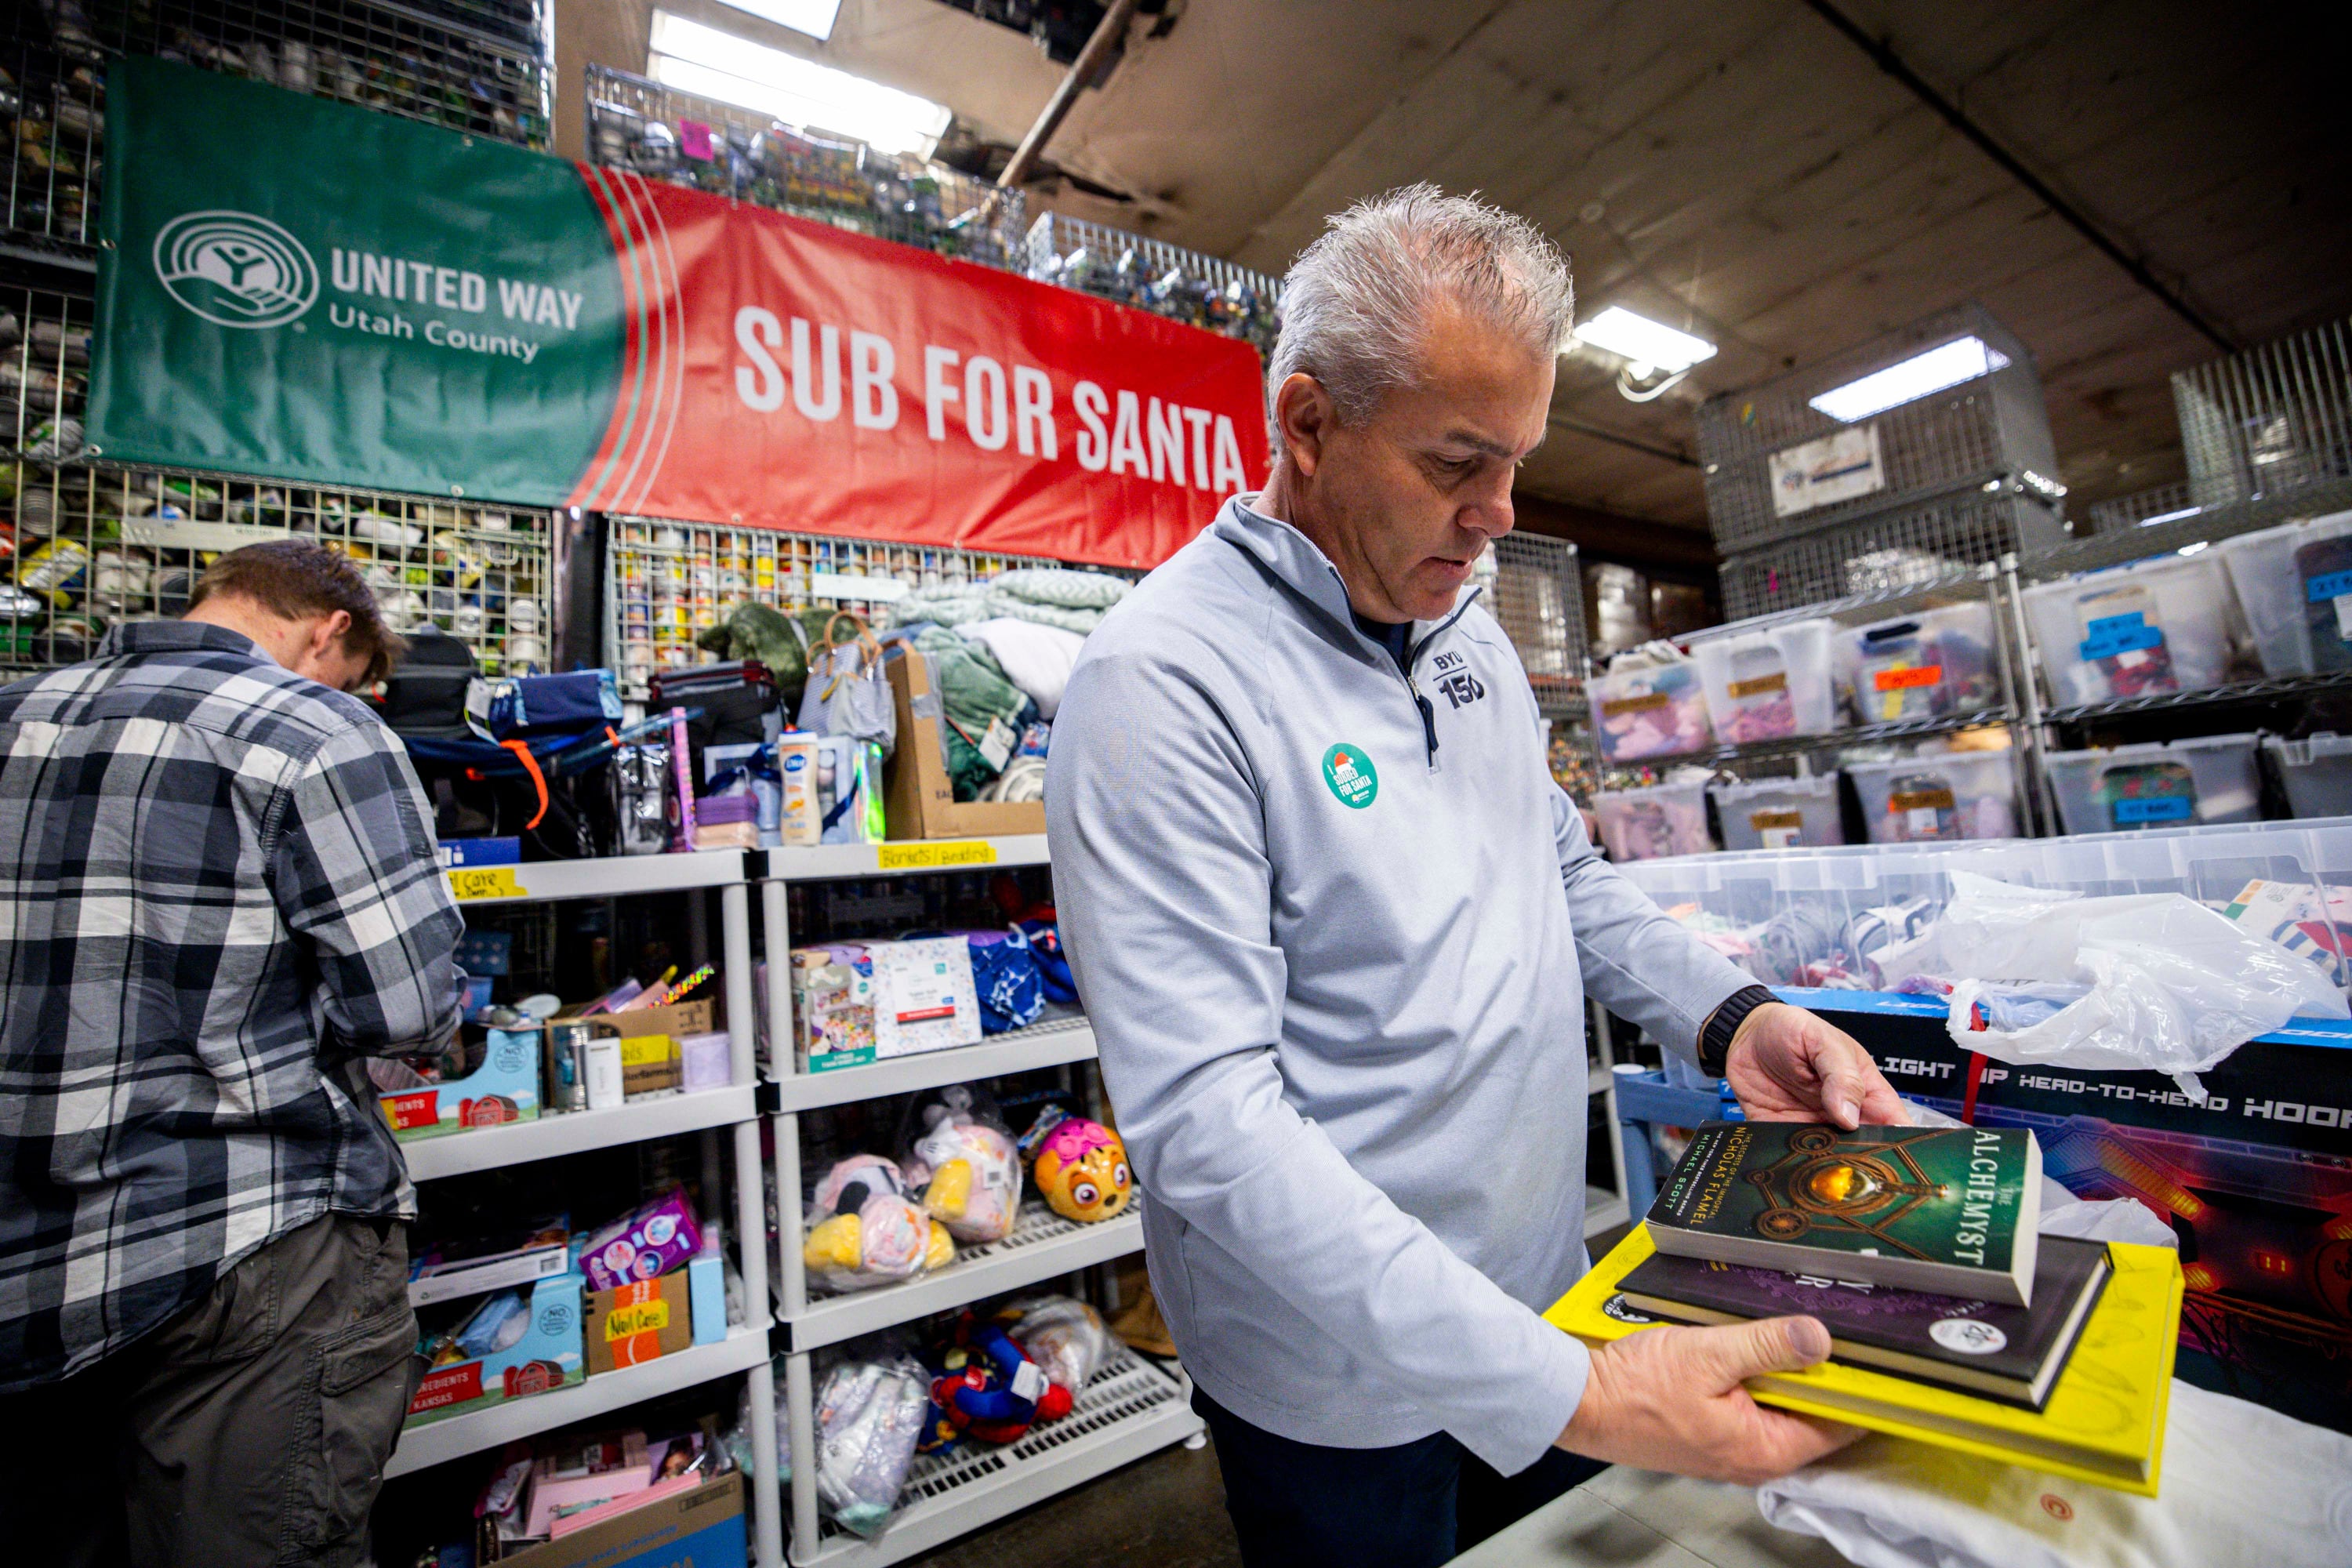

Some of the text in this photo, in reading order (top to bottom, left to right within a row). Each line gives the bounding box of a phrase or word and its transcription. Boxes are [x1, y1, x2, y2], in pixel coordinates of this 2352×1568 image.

[331, 248, 583, 331] UNITED WAY
[329, 303, 539, 365] Utah County
[734, 306, 1248, 493] SUB FOR SANTA
[1433, 651, 1463, 670] BYU
[1439, 673, 1484, 710] 150
[1327, 764, 1334, 775] I
[1333, 768, 1359, 786] SUBBED
[1339, 782, 1354, 797] FOR
[1350, 775, 1372, 791] SANTA
[1744, 1134, 1753, 1144] THE
[1713, 1127, 1747, 1178] NICHOLAS
[1733, 1145, 1748, 1166] SECRETS
[1665, 1134, 1710, 1210] MICHAEL SCOTT
[1723, 1177, 1733, 1187] THE
[1690, 1182, 1720, 1225] FLAMEL
[1708, 1189, 1727, 1219] IMMORTAL
[1954, 1131, 2001, 1266] ALCHEMYST
[1998, 1187, 2013, 1207] THE
[550, 1308, 567, 1317] NO
[413, 1392, 453, 1410] KANSAS
